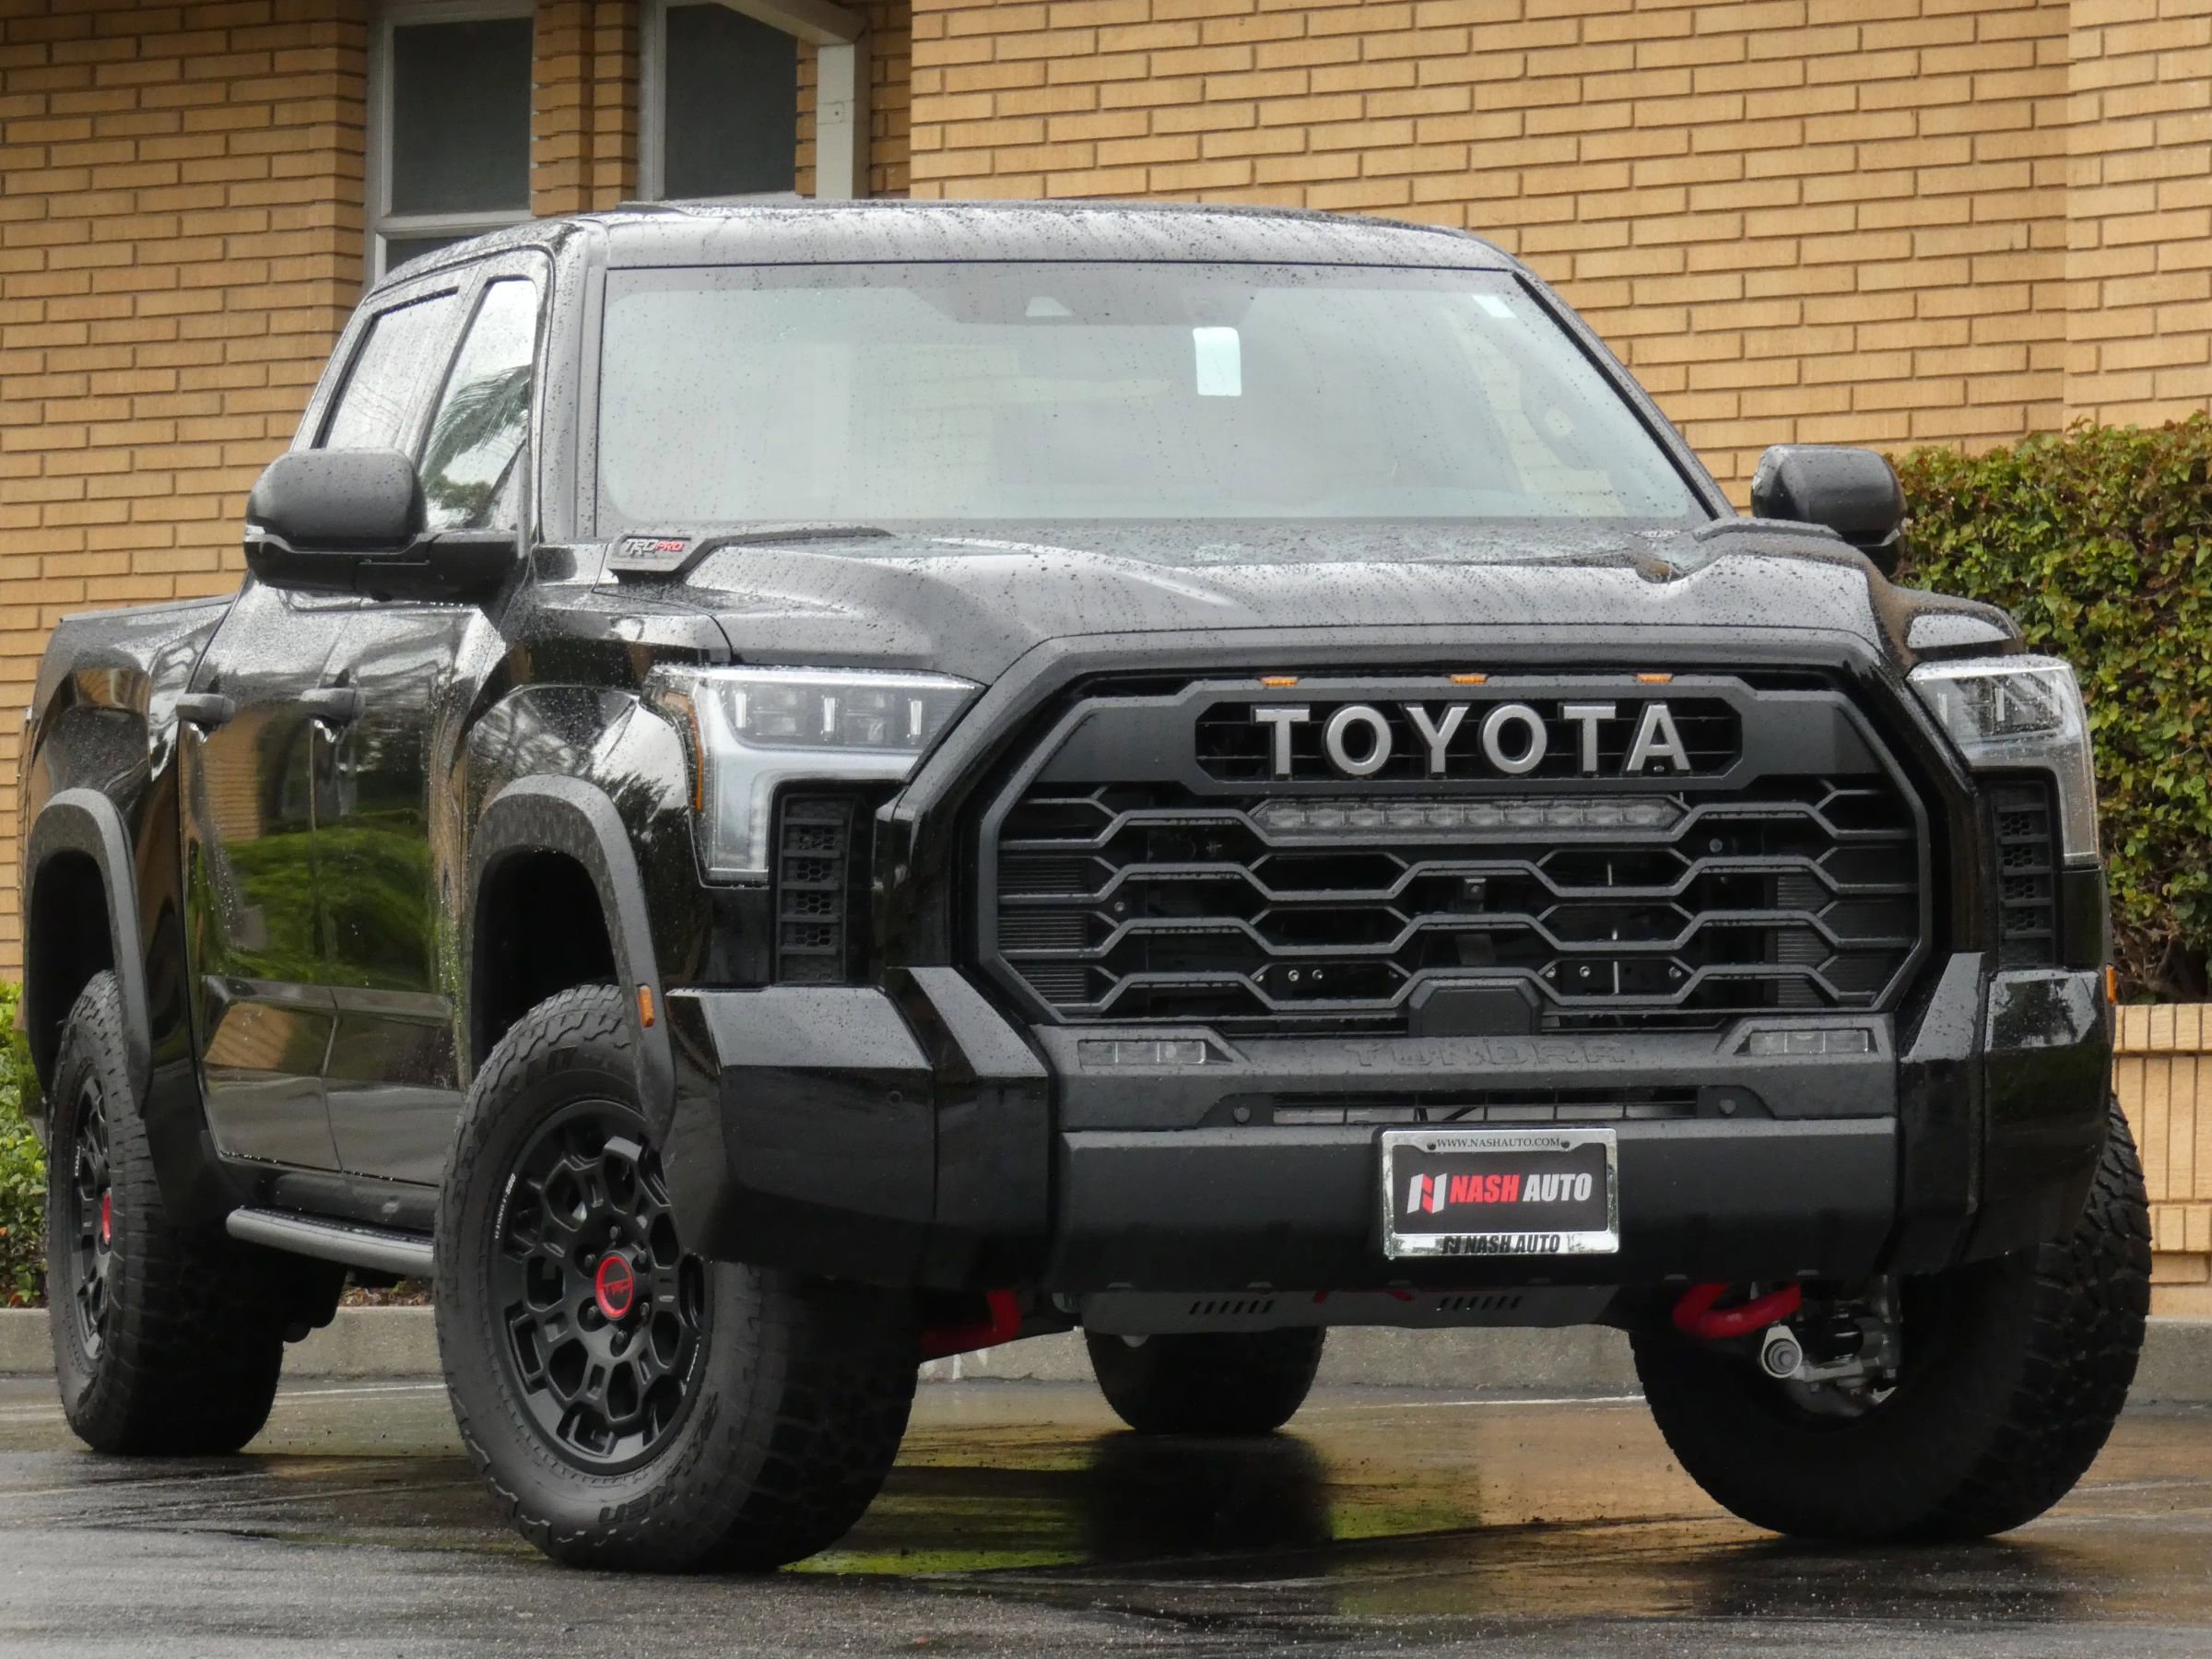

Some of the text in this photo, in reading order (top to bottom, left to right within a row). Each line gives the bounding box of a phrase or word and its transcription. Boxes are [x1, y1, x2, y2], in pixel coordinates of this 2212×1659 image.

[627, 538, 685, 555] TRD PRO
[1252, 702, 1692, 776] TOYOTA
[1436, 1137, 1560, 1148] WWW.NASHAUTO.COM
[1449, 1174, 1522, 1204] NASH
[1522, 1172, 1593, 1202] AUTO
[1463, 1234, 1512, 1253] NASH
[1514, 1233, 1560, 1253] AUTO
